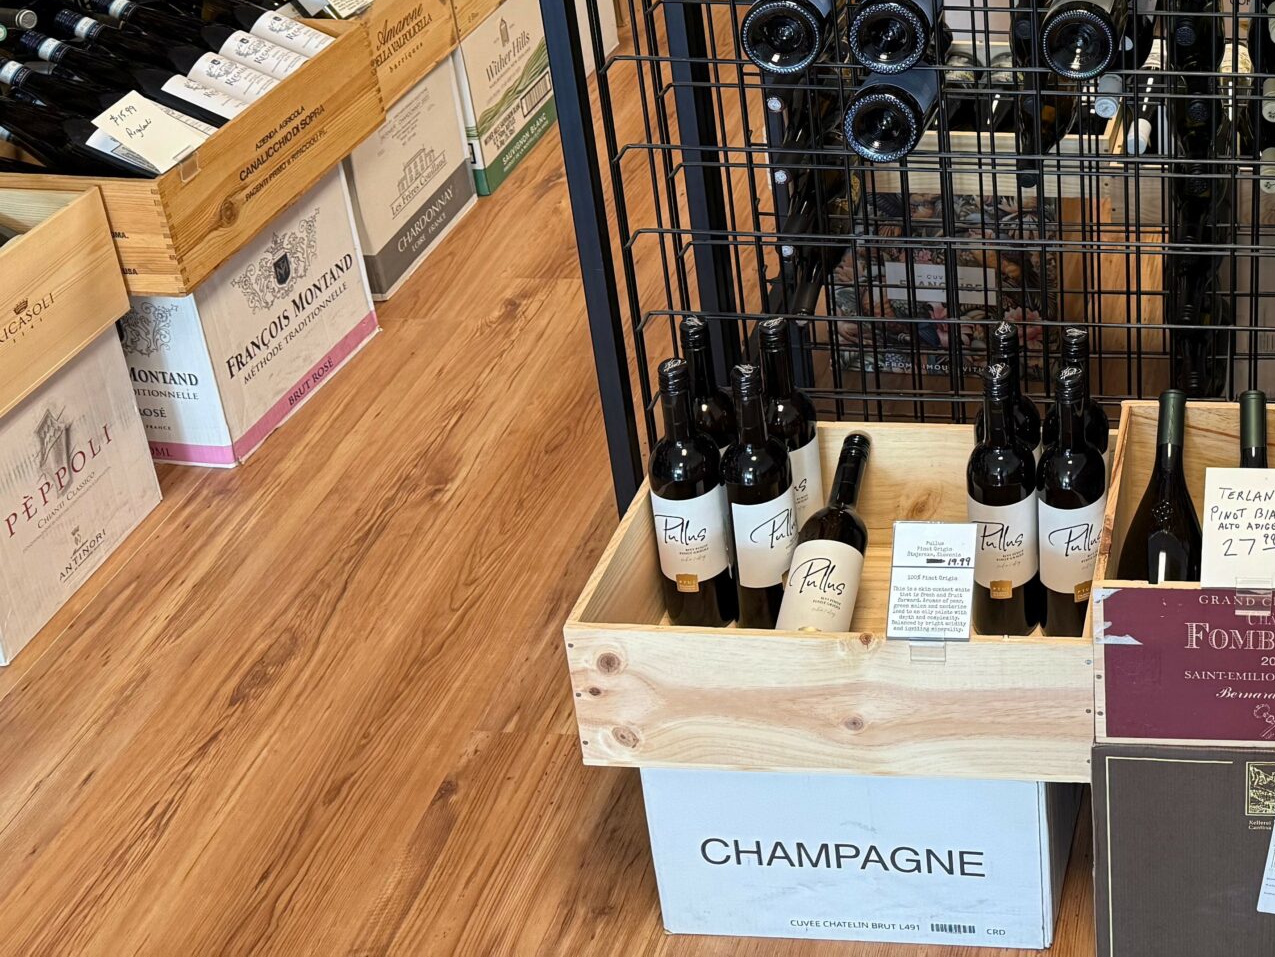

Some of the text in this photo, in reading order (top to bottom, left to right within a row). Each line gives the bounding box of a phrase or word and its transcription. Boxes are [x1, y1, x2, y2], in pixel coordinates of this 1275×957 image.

[377, 4, 423, 51] Amarone
[485, 32, 531, 83] Wither Hills
[240, 131, 292, 182] CANALICCHIO
[300, 105, 325, 130] SOPRA
[255, 128, 278, 151] AZIENDA
[502, 130, 530, 166] SAUVIGNON
[530, 112, 547, 139] BLANC
[391, 202, 402, 217] Les
[401, 185, 420, 205] Frères
[398, 185, 454, 253] CHARDONNAY
[412, 212, 447, 252] LOIRE FRANCE
[0, 293, 54, 342] ICASOLI
[226, 253, 353, 380] FRANÇOIS MONTAND
[243, 281, 348, 384] MÉTHODE TRADITIONNELLE
[287, 357, 334, 407] BRUT ROSÉ
[4, 423, 113, 538] PÈPPOLI
[37, 471, 95, 530] CHIANTI CLASSICO
[655, 515, 707, 546] Pullus
[1210, 507, 1247, 521] PINOT
[1218, 522, 1240, 531] ALTO
[59, 529, 107, 581] ANTINORI
[971, 521, 1024, 552] Pullus
[789, 558, 846, 595] Pullus
[948, 557, 971, 566] 19.99
[1198, 594, 1256, 606] GRAND
[1215, 687, 1275, 701] Bernard
[700, 836, 986, 877] CHAMPAGNE
[790, 919, 821, 928] CUVEE
[823, 921, 869, 929] CHATELIN
